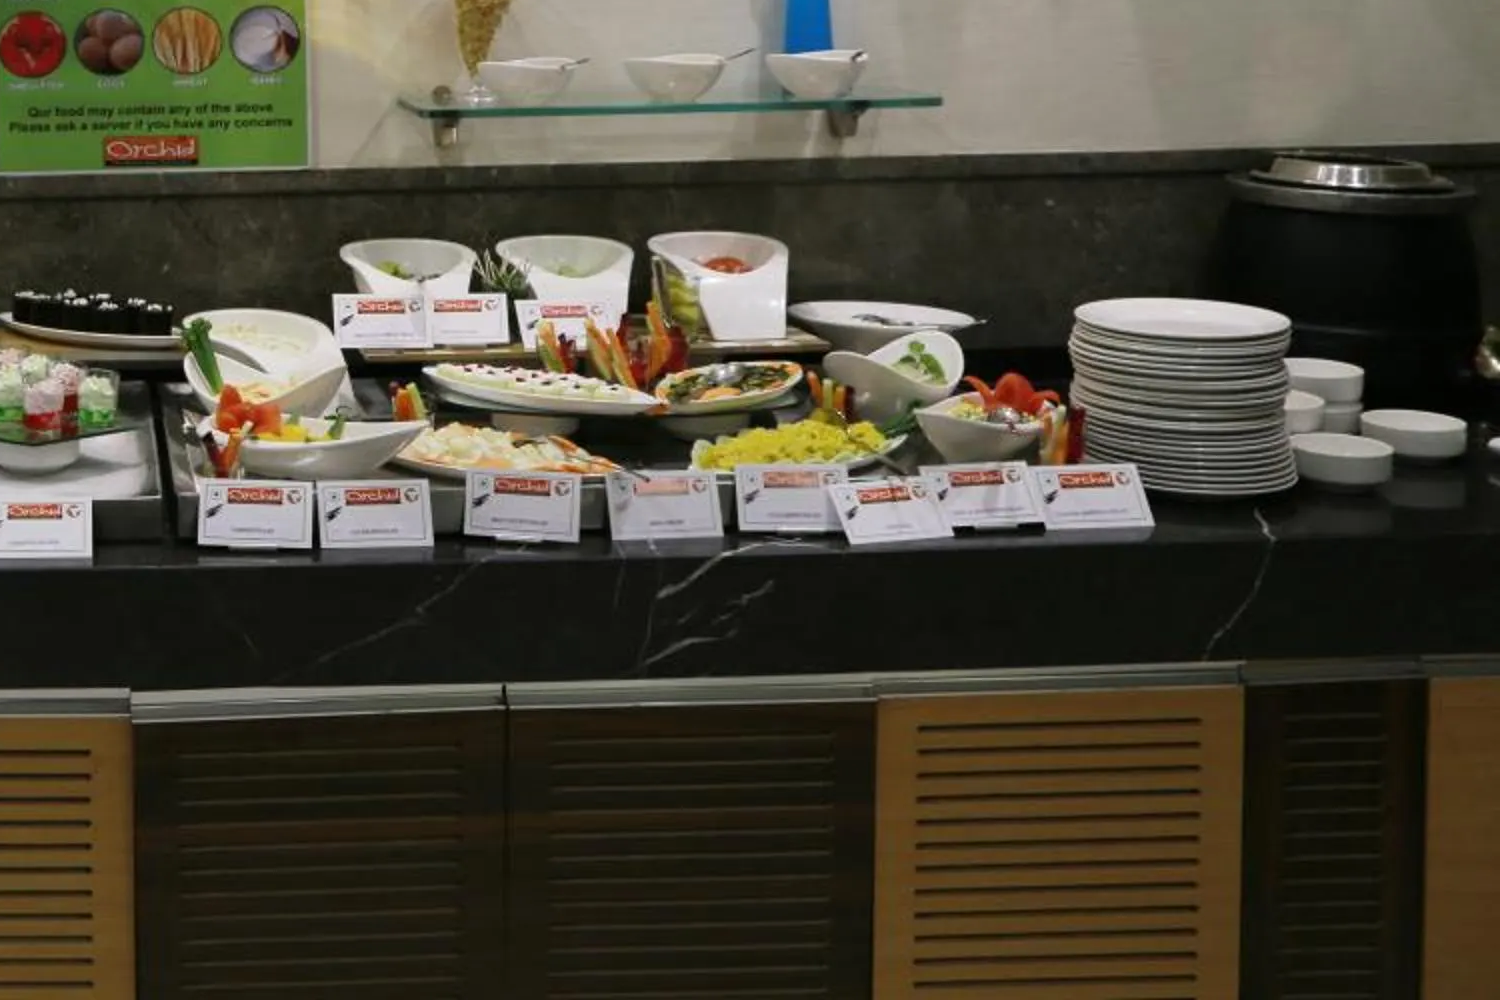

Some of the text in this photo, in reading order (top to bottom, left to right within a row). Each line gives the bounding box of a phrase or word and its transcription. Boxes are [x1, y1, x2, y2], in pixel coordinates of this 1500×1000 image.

[28, 103, 273, 119] Our food may contain any of the above
[9, 121, 51, 132] Please
[55, 120, 77, 131] ask
[92, 121, 132, 131] server
[134, 119, 144, 130] if
[147, 120, 171, 132] you
[173, 118, 204, 129] have
[207, 119, 231, 131] any
[234, 118, 293, 128] concerns
[107, 138, 195, 158] Orchid
[495, 478, 550, 493] Orchid
[1059, 474, 1113, 486] Orchid
[229, 488, 283, 502] Orchid
[347, 489, 400, 502] Orchid
